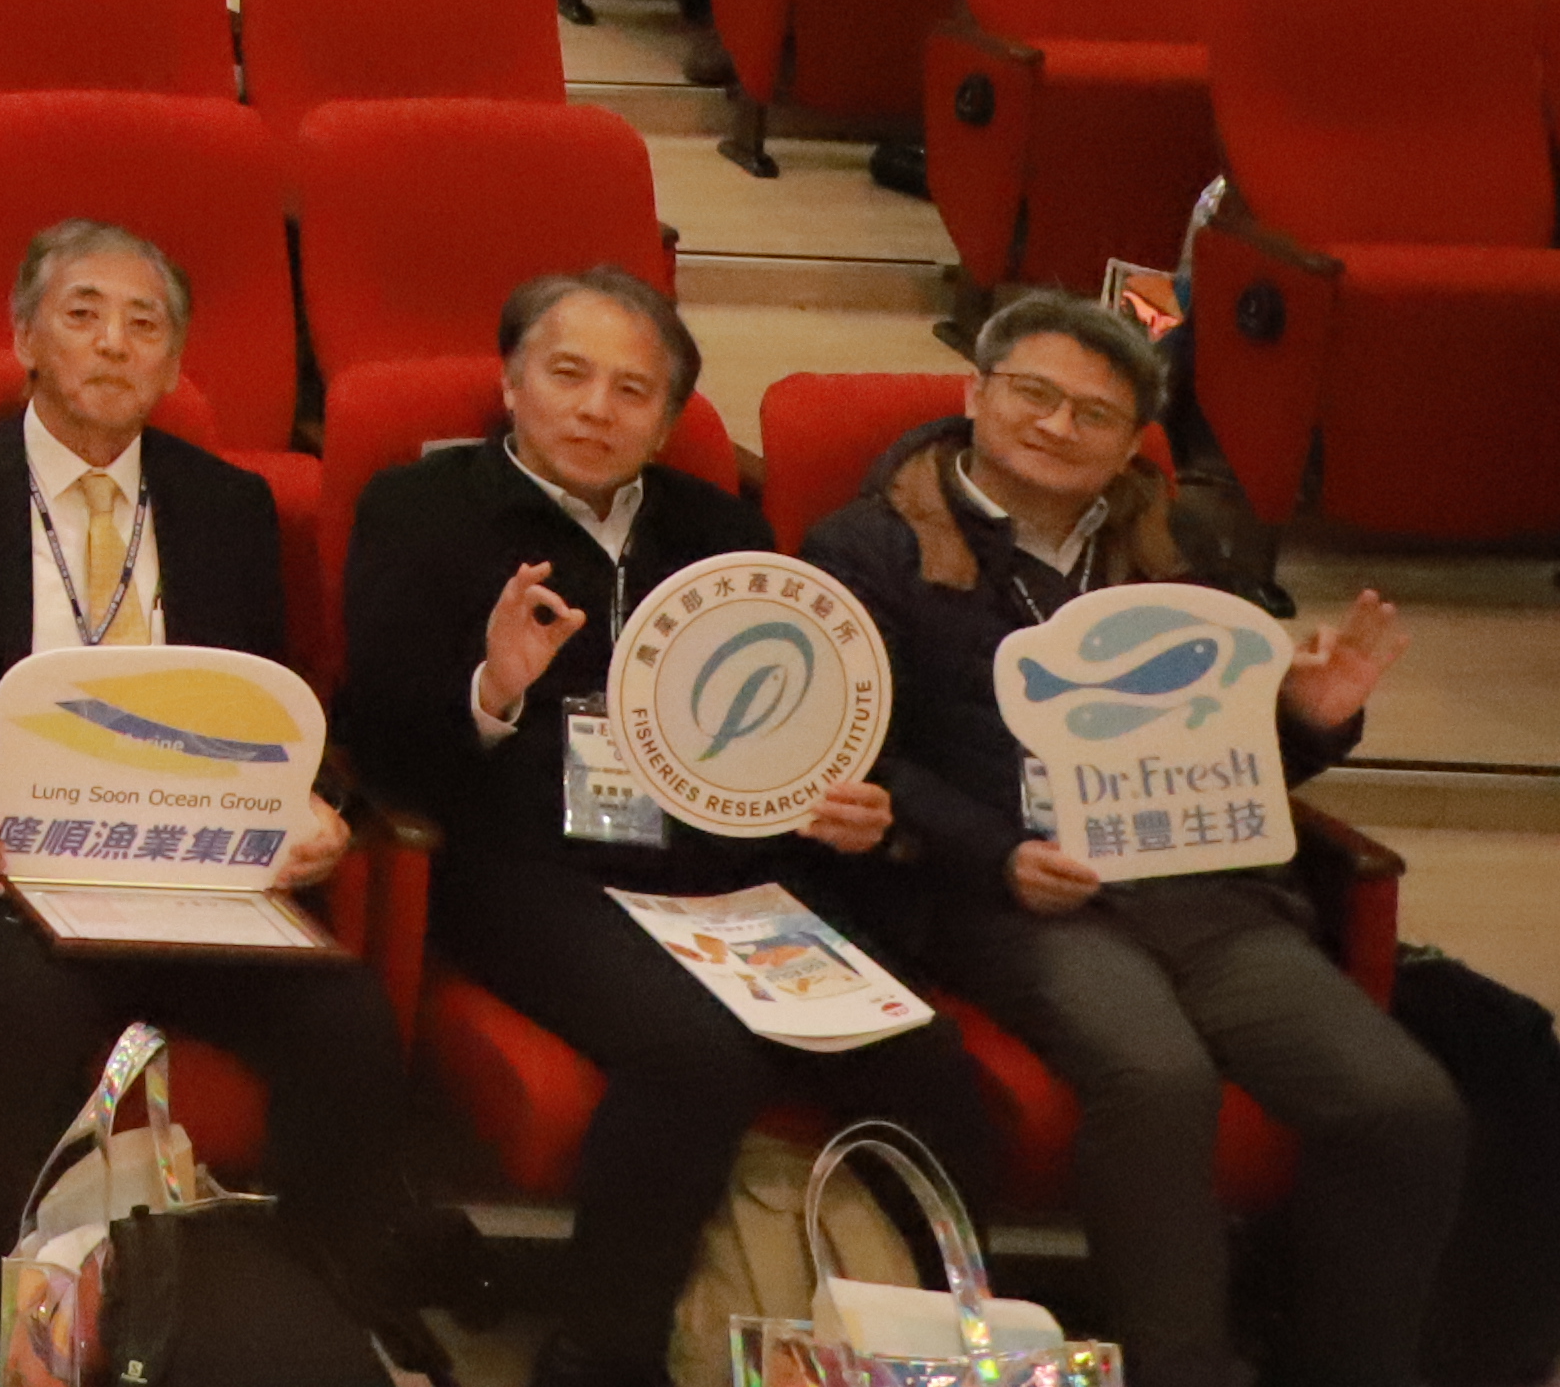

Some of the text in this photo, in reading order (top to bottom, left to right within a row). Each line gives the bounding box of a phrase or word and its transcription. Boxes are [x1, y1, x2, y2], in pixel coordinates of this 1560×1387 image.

[635, 572, 860, 669] 農業部水產試驗所
[631, 707, 701, 802] FISHERIES
[704, 782, 821, 819] RESEARCH
[823, 678, 873, 784] INSTITUTE
[31, 783, 282, 814] Lung Soon Ocean Group
[1084, 798, 1270, 859] 鮮豐生技
